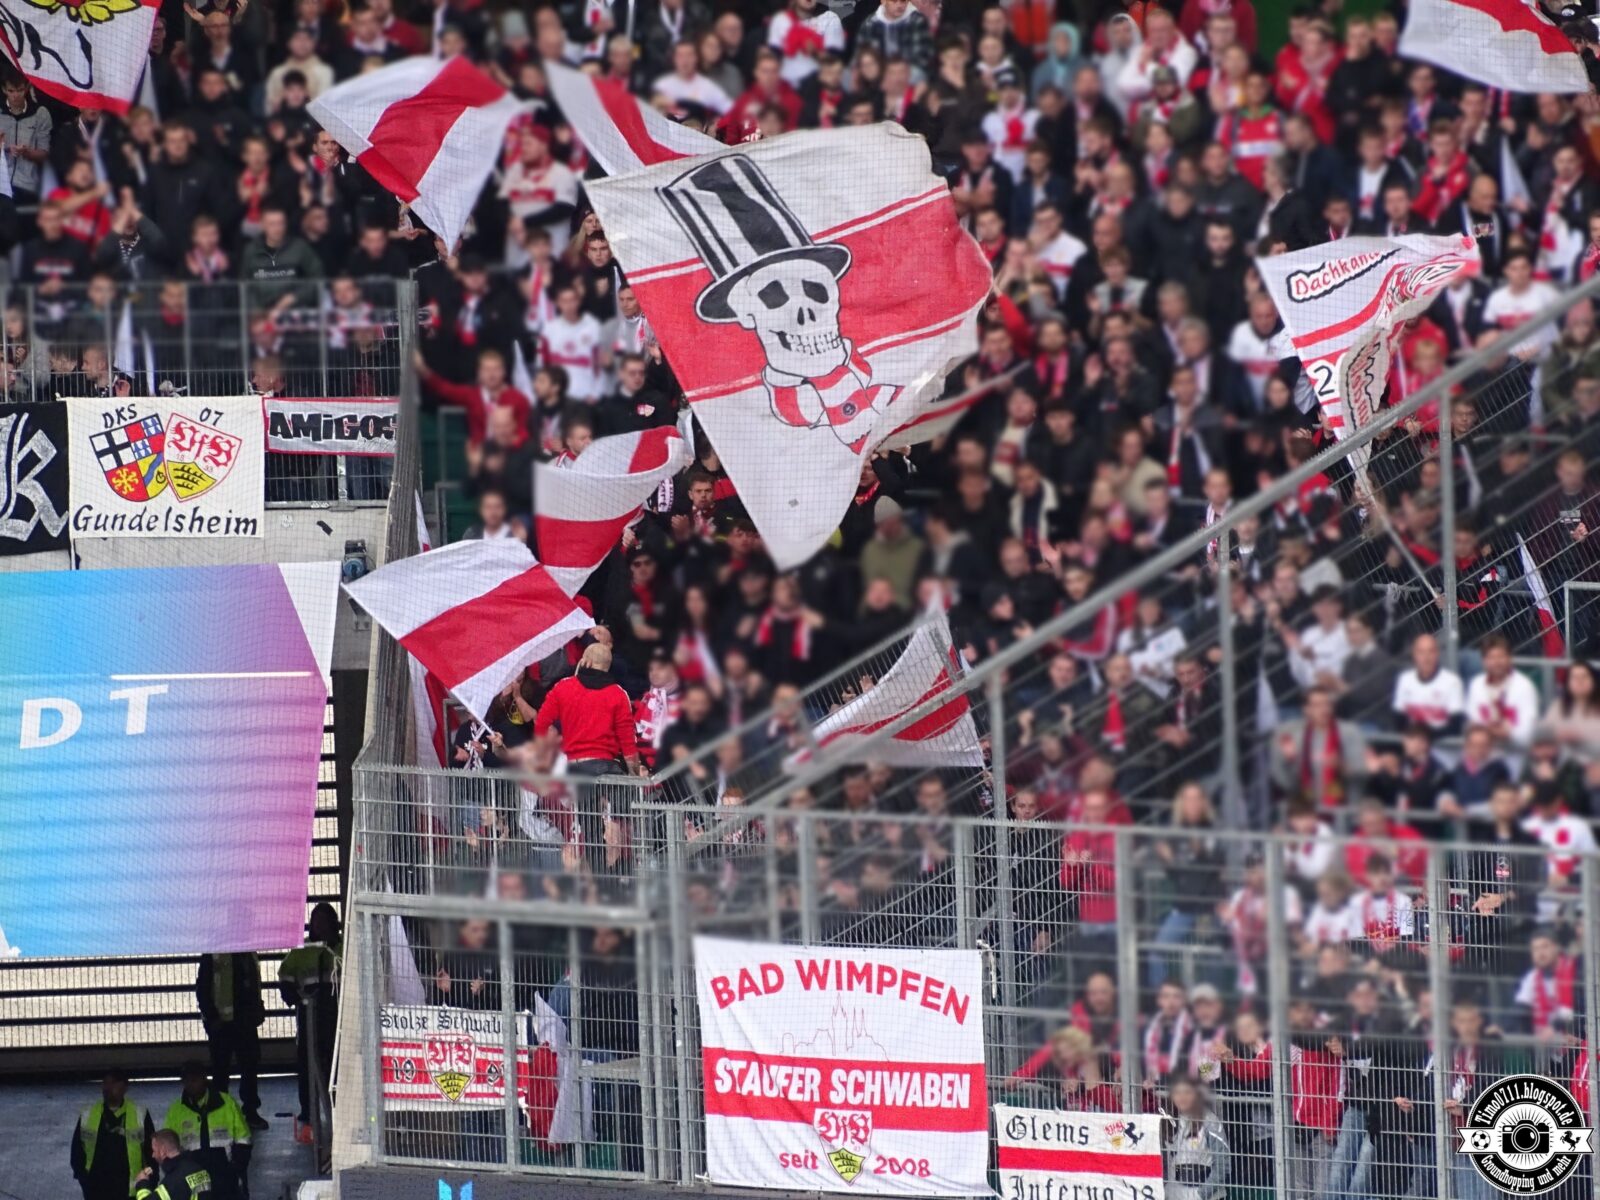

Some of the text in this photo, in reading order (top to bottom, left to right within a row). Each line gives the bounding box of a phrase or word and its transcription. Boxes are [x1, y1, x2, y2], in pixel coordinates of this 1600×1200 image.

[1295, 251, 1380, 296] Dachkan
[103, 403, 224, 428] DKS 07
[73, 504, 258, 536] Gundelsheim
[710, 958, 970, 1025] BAD WIMPFEN
[714, 1056, 971, 1109] STAUFER SCHWABEN
[1005, 1114, 1089, 1146] Glems
[779, 1151, 931, 1178] seit 2008
